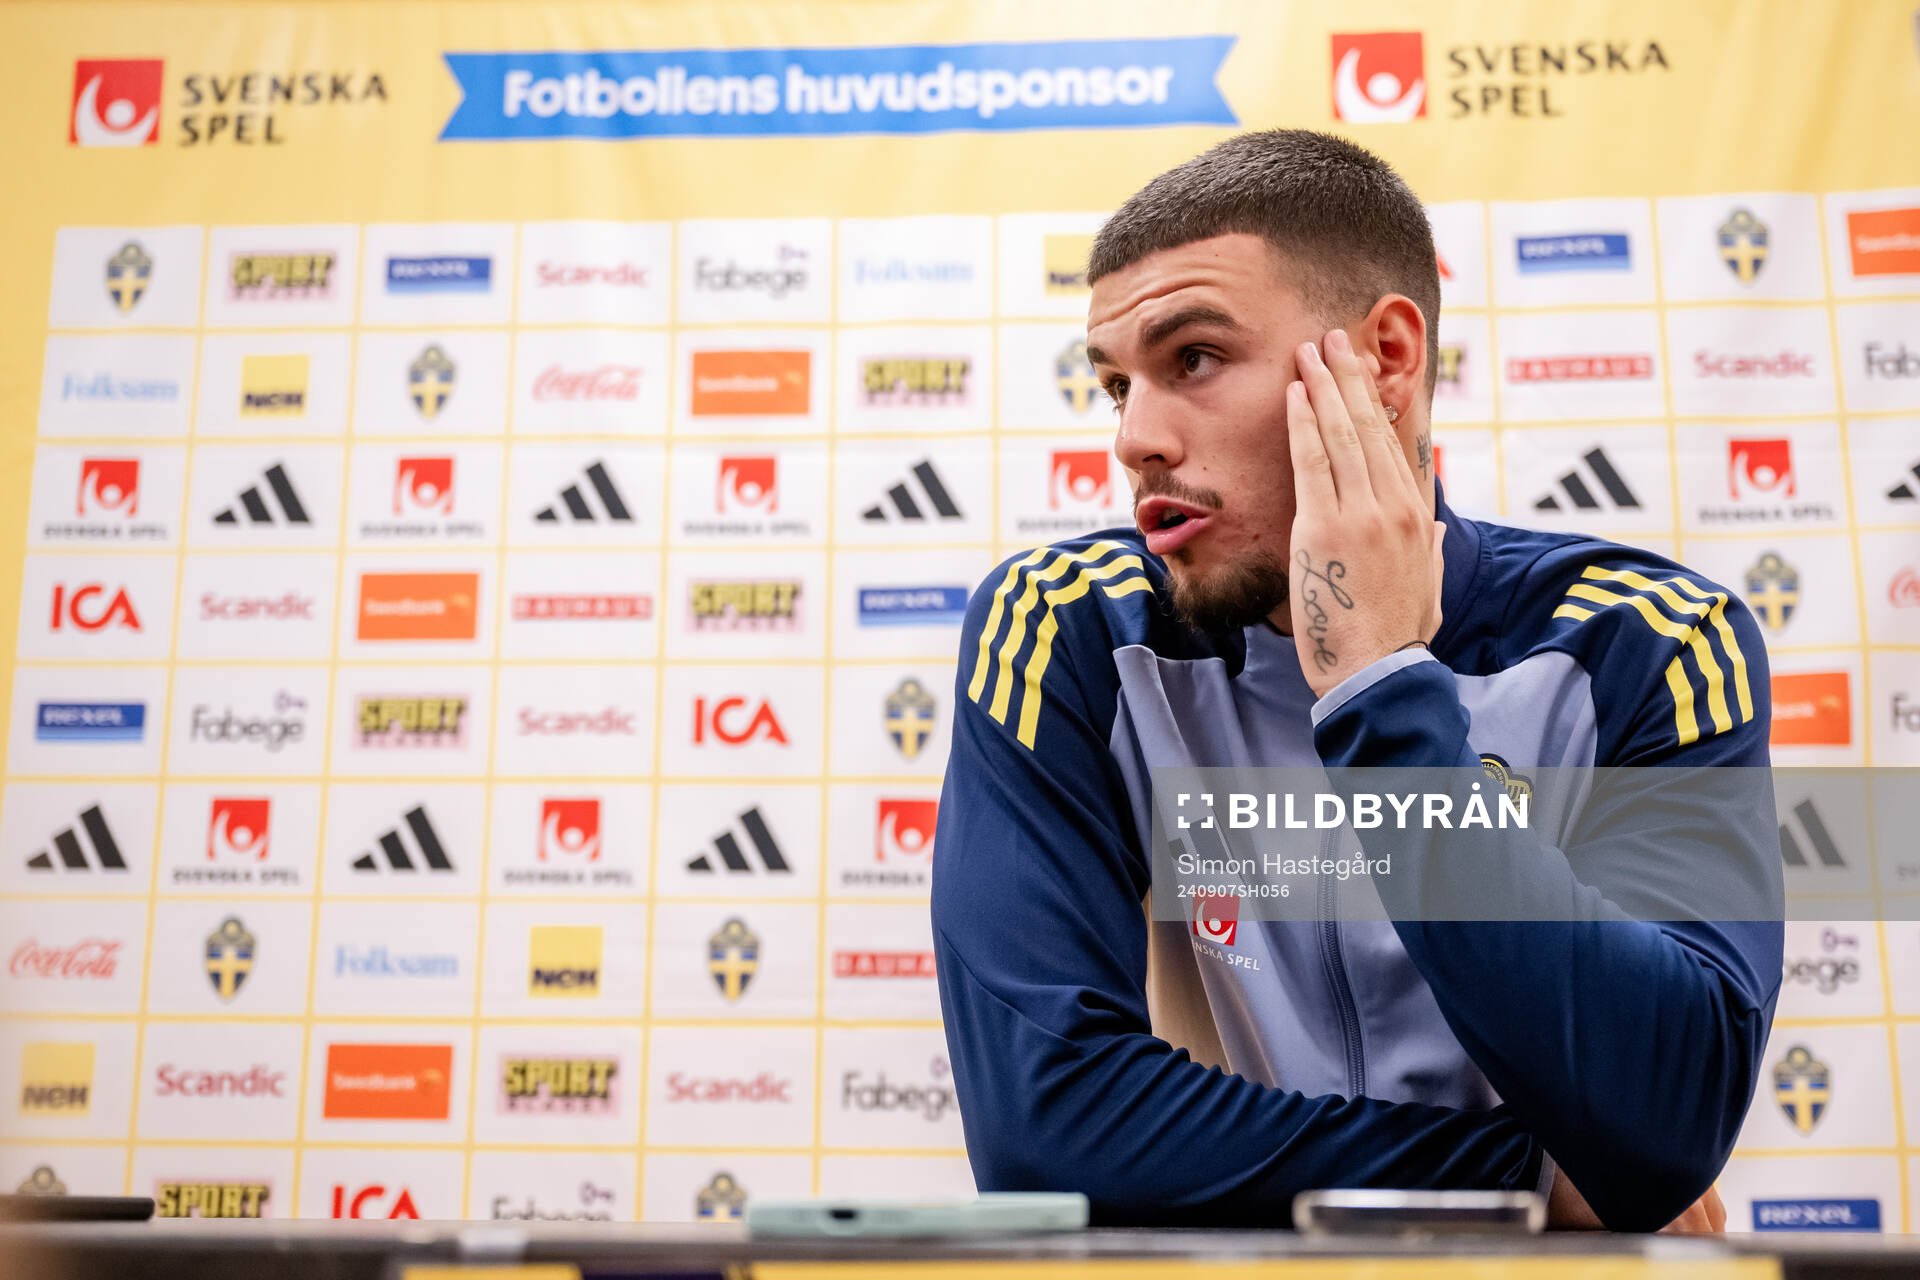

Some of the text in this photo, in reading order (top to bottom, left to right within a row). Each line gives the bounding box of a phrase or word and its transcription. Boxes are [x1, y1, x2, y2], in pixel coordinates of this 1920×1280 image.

[1446, 40, 1671, 78] SVENSKA
[180, 73, 389, 107] SVENSKA
[503, 61, 1173, 119] Fotbollens huvudsponsor
[1450, 86, 1566, 120] SPEL
[178, 115, 285, 147] SPEL
[695, 257, 808, 299] Fabege
[1863, 340, 1920, 380] Fab
[49, 583, 143, 632] ICA
[199, 594, 316, 621] Scandic
[1296, 548, 1355, 676] Love
[191, 706, 305, 752] Fabege
[359, 697, 467, 734] SPORT
[516, 706, 637, 736] Scandic
[692, 695, 790, 746] ICA
[834, 951, 937, 978] BAUHA
[1193, 941, 1261, 971] NSKA SPEL
[1784, 956, 1861, 995] ege
[155, 1063, 286, 1097] Scandic
[503, 1058, 617, 1100] SPORT
[666, 1071, 792, 1103] Scandic
[157, 1184, 270, 1218] SPORT
[330, 1184, 421, 1219] ICA
